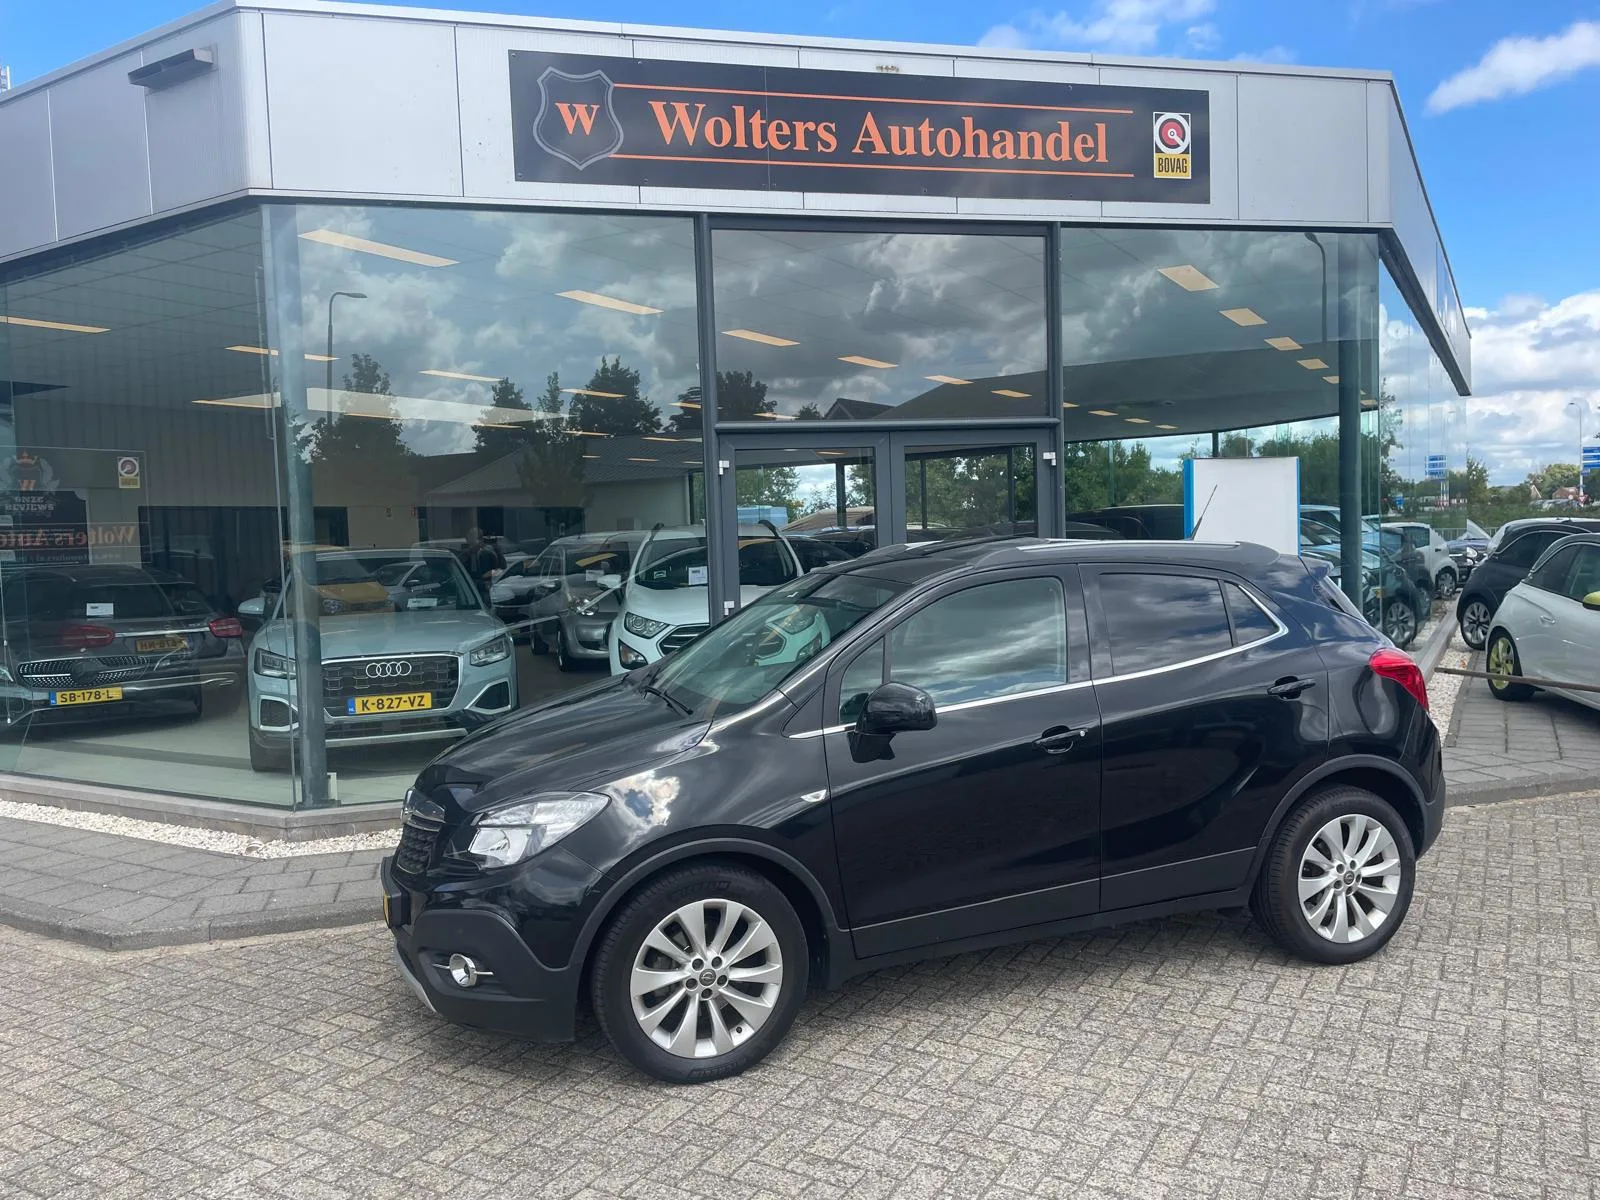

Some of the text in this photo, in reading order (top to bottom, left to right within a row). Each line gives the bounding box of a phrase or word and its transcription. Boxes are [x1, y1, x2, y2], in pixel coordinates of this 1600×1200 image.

[555, 102, 600, 135] W
[648, 100, 1109, 163] Wolters Autohandel
[1157, 157, 1188, 174] BOVAG
[4, 503, 56, 511] REVIEWS
[60, 690, 113, 703] SB-178-L
[361, 695, 425, 711] K-827-VZ
